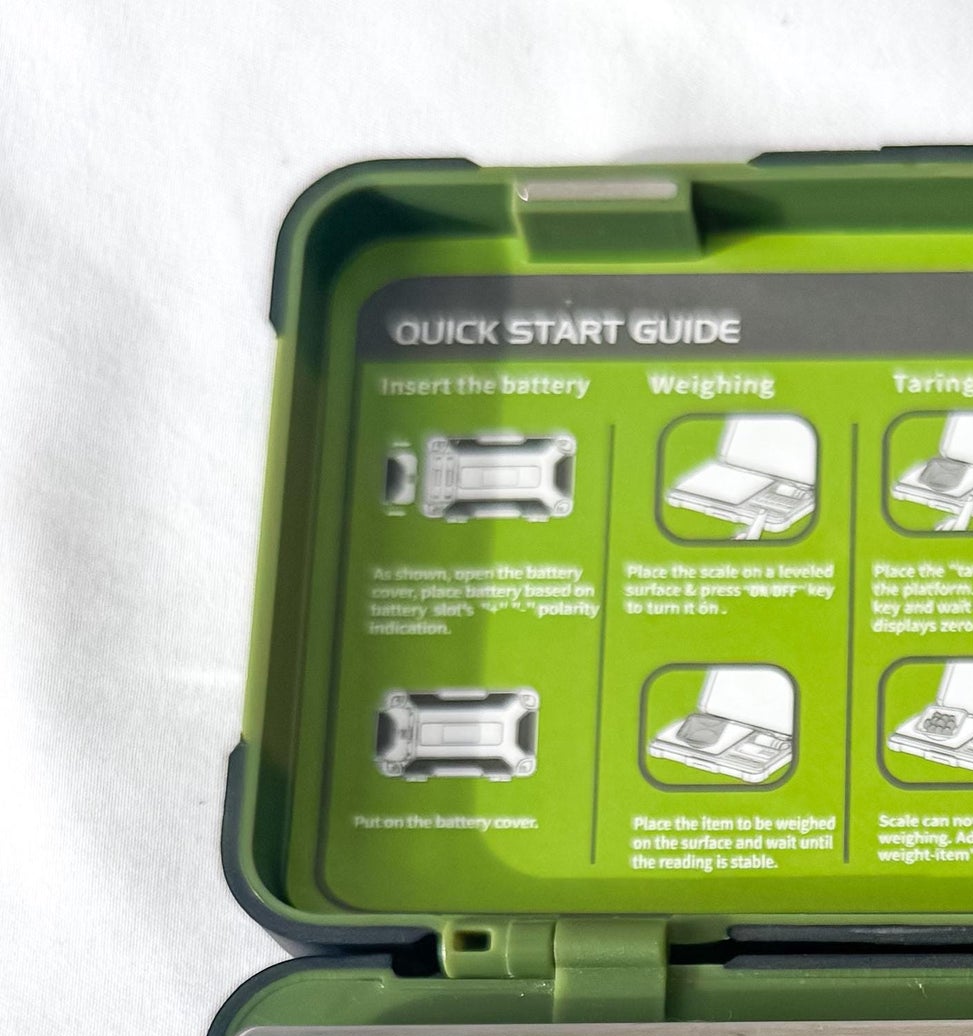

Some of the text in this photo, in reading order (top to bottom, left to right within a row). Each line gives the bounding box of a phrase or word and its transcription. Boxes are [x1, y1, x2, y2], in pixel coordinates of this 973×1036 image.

[396, 319, 741, 344] QUICK START GUIDE
[381, 375, 590, 398] Insert the battery
[649, 374, 774, 398] Weighing
[374, 566, 583, 583] As shown, open the battery
[627, 564, 834, 578] Place the scale on a leveled
[873, 564, 915, 577] Place
[918, 564, 944, 577] the
[372, 584, 594, 600] cover, place battery based on
[625, 584, 680, 597] surface
[685, 584, 696, 597] &
[701, 586, 741, 600] press
[808, 584, 834, 600] key
[873, 583, 898, 595] the
[371, 604, 427, 618] battery
[538, 602, 600, 619] polarity
[626, 602, 643, 614] to
[647, 602, 680, 614] turn
[684, 601, 694, 614] it
[873, 603, 900, 617] key
[904, 602, 934, 613] and
[937, 602, 971, 613] wait
[369, 622, 451, 634] indication.
[873, 620, 937, 635] displays
[355, 815, 539, 832] Put on the battery cover.
[634, 816, 835, 834] Place the item to be weighed
[879, 814, 919, 827] Scale
[923, 817, 949, 827] can
[633, 836, 833, 849] on the surface and wait until
[878, 832, 952, 847] weighing.
[633, 855, 778, 872] the reading is stable.
